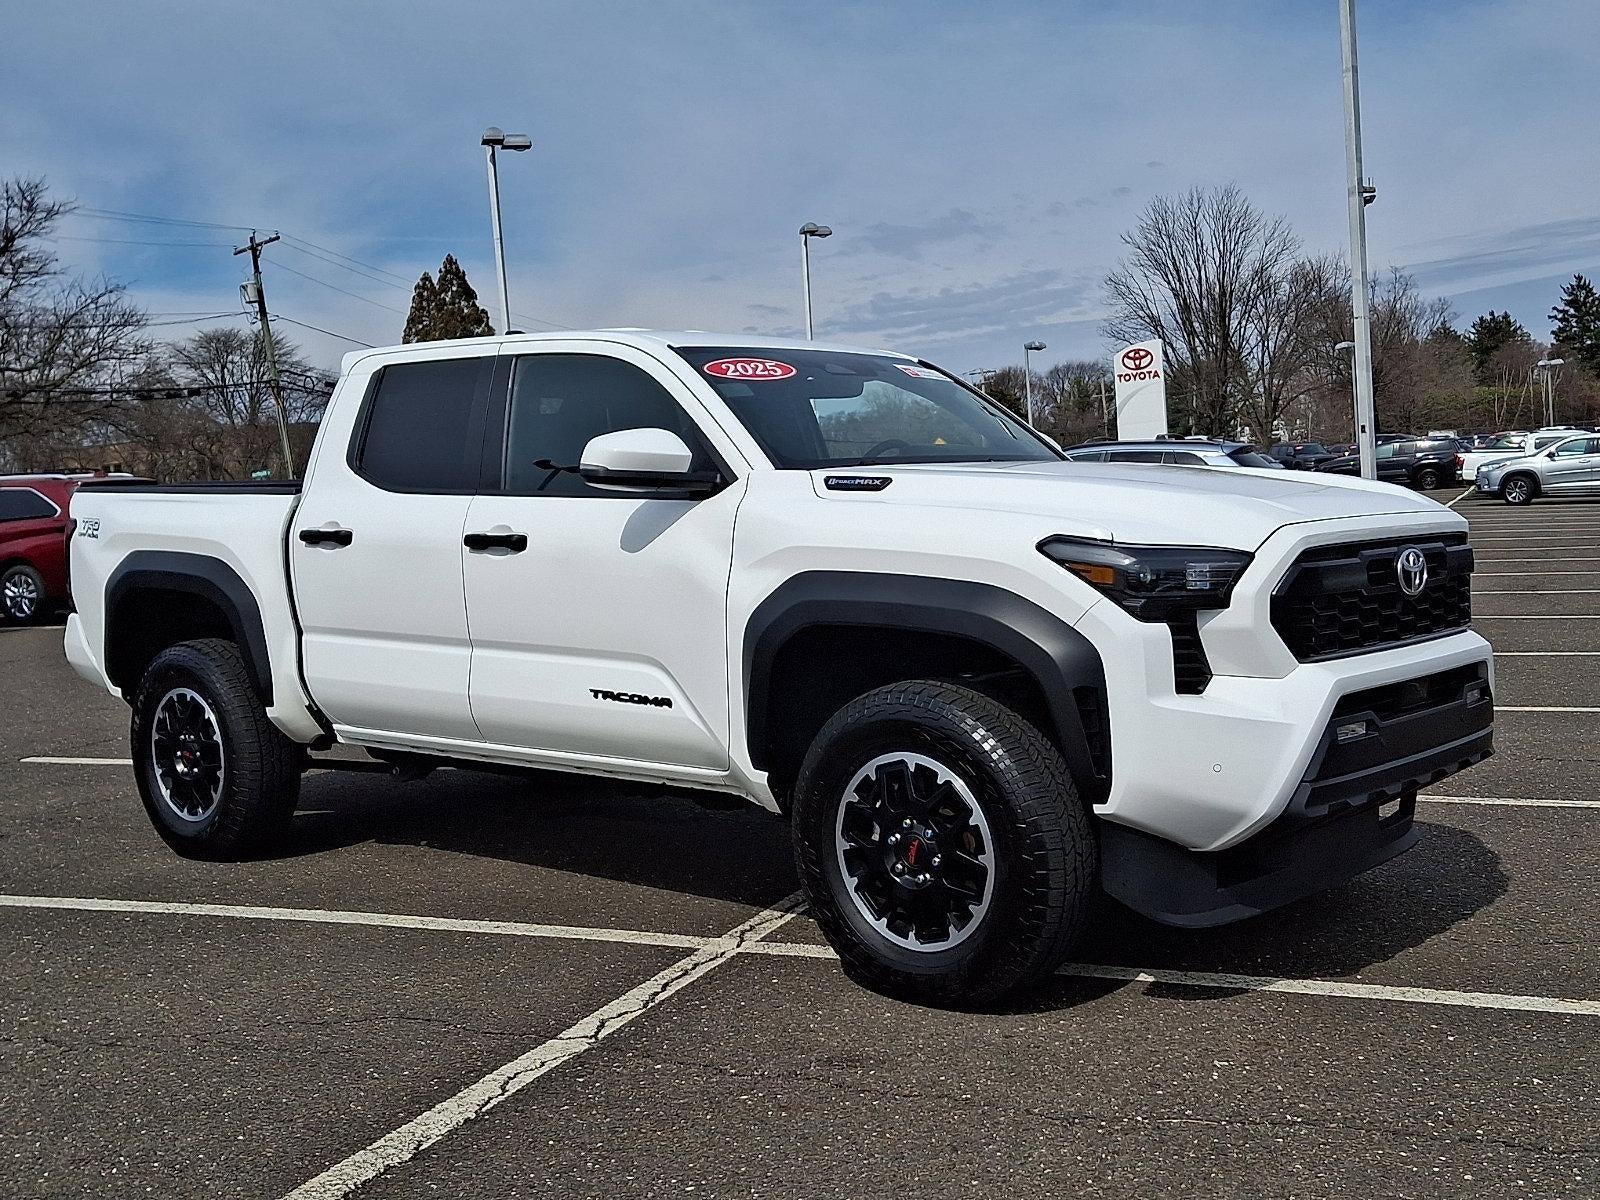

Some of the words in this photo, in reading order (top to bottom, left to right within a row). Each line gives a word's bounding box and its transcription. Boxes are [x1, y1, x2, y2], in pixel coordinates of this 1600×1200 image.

[721, 362, 783, 376] 2025
[1117, 370, 1160, 383] TOYOTA
[589, 689, 673, 709] TACOMA
